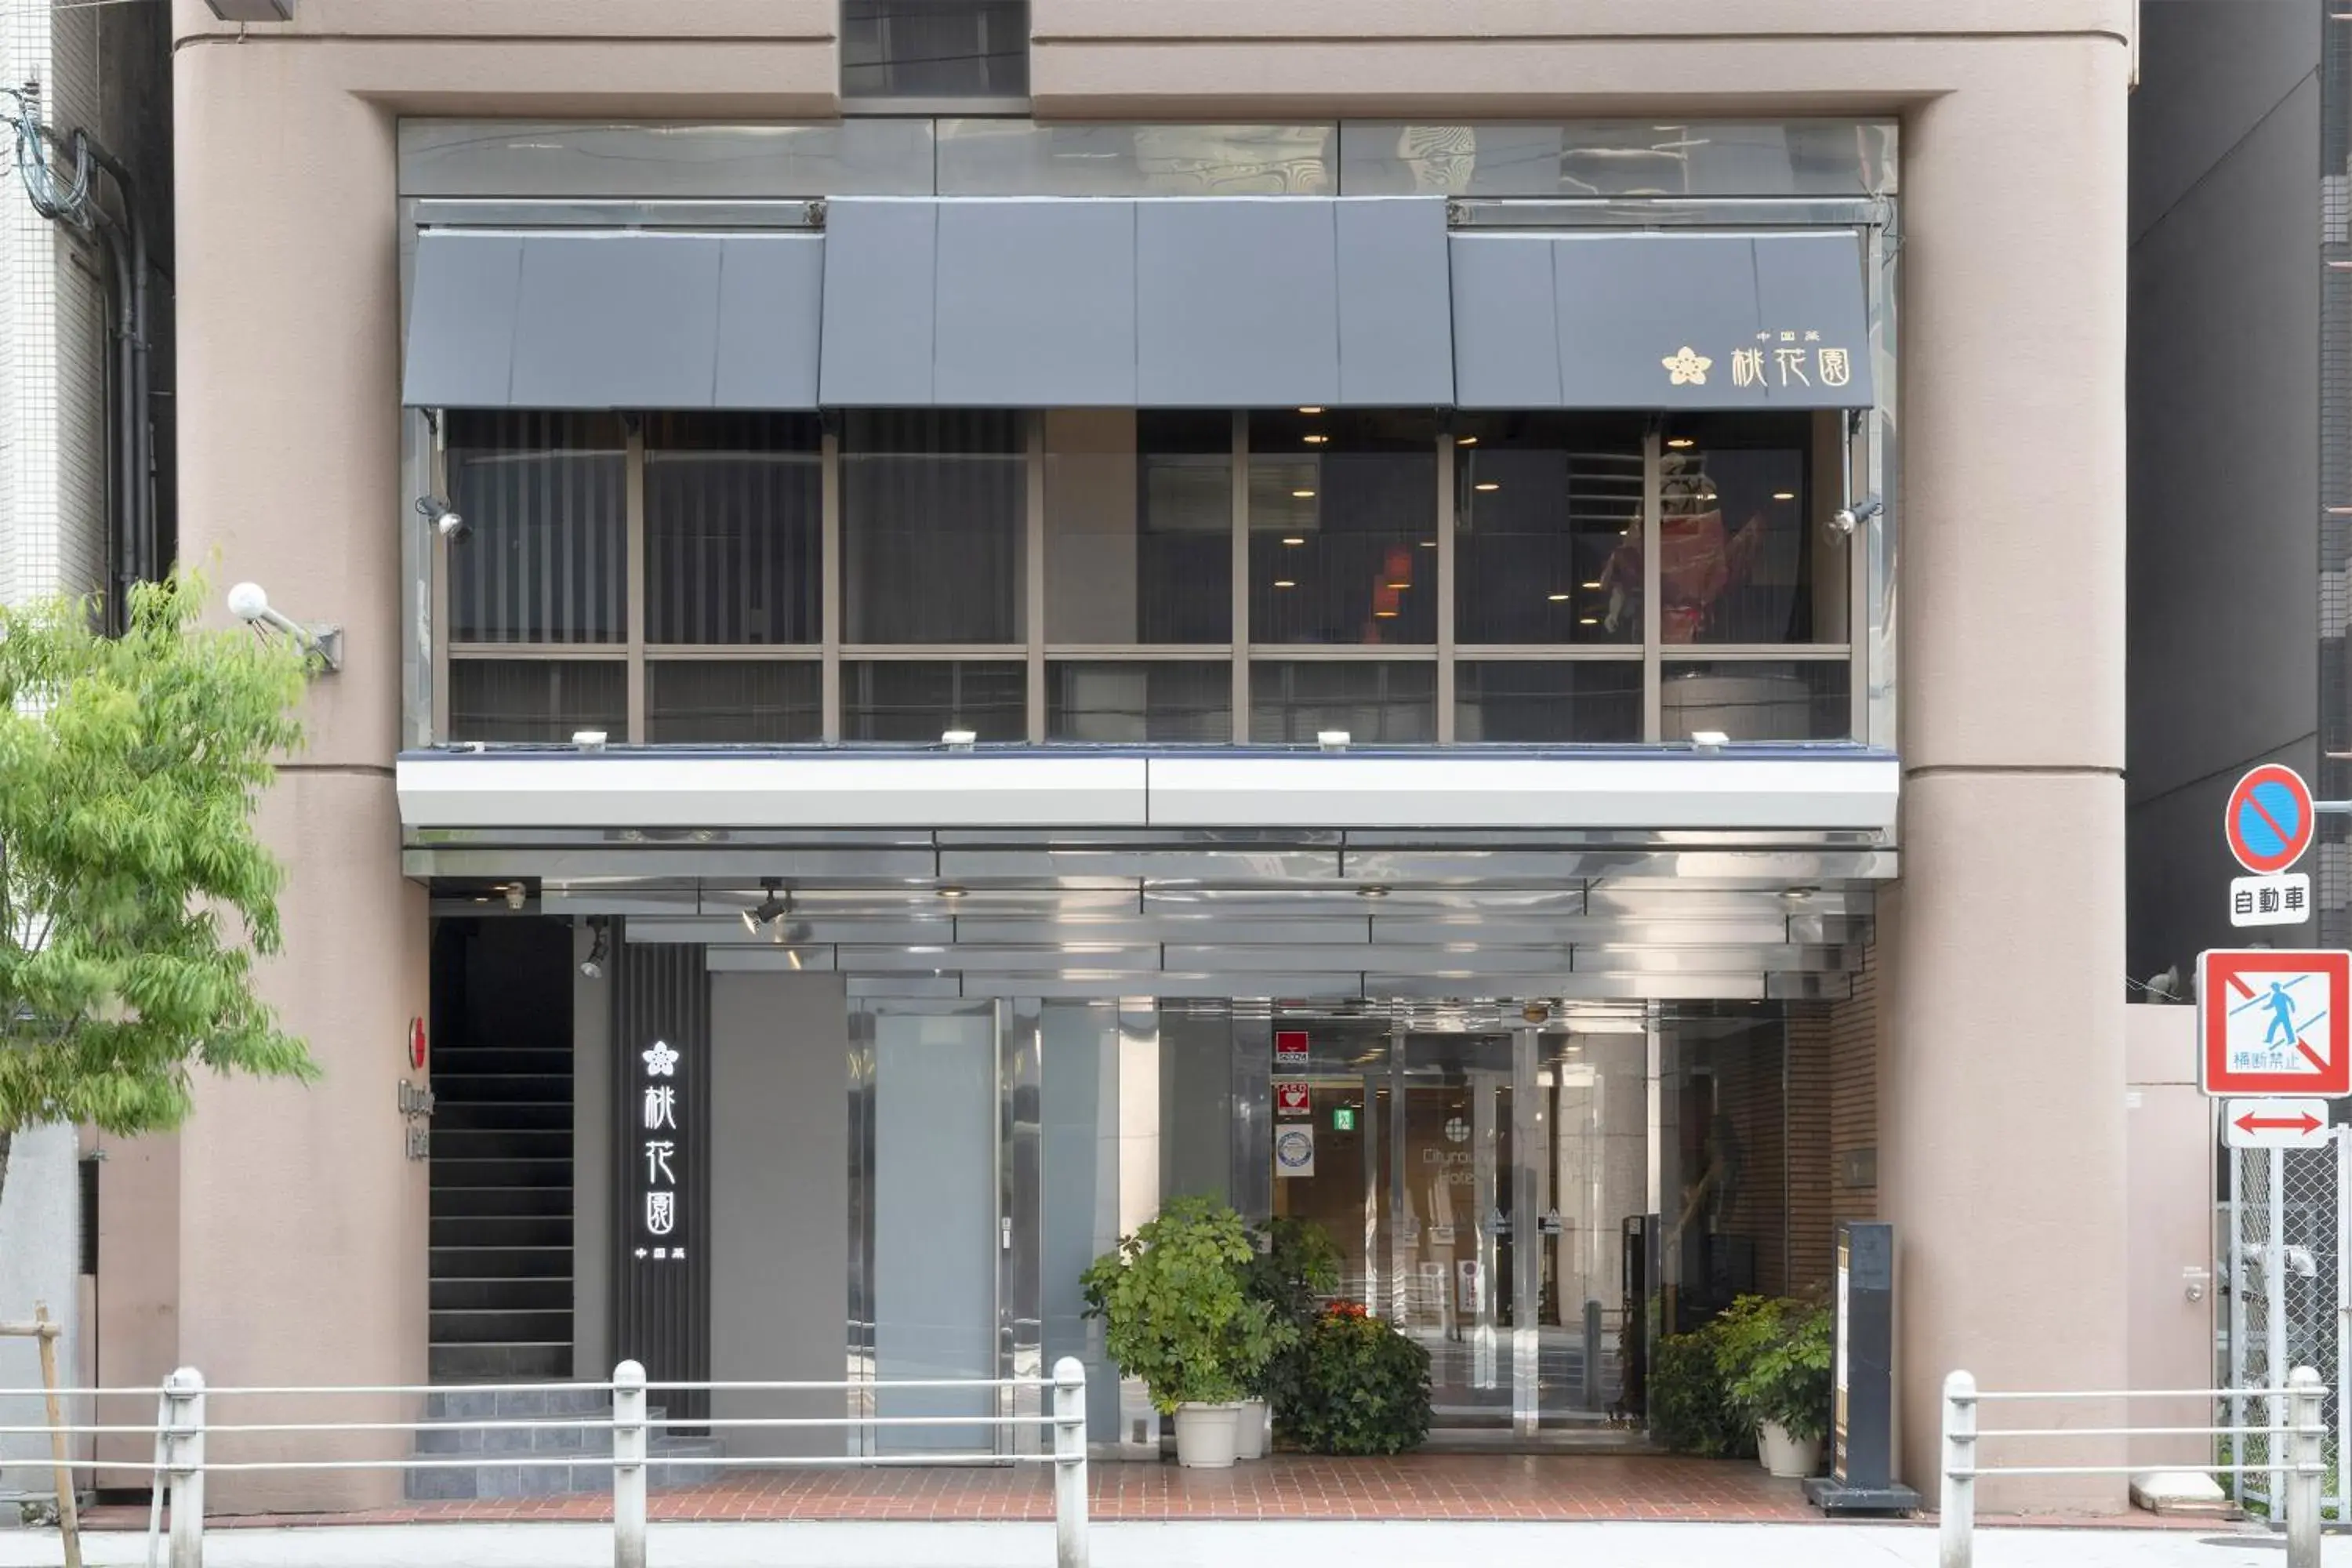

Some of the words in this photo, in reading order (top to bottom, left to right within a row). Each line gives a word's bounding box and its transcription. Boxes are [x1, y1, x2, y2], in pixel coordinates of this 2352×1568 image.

[1730, 347, 1850, 387] 桃花園
[2234, 885, 2305, 915] 自動車
[2233, 1051, 2302, 1070] 横断禁止
[1280, 1083, 1307, 1092] AED
[644, 1085, 677, 1235] 桃花園
